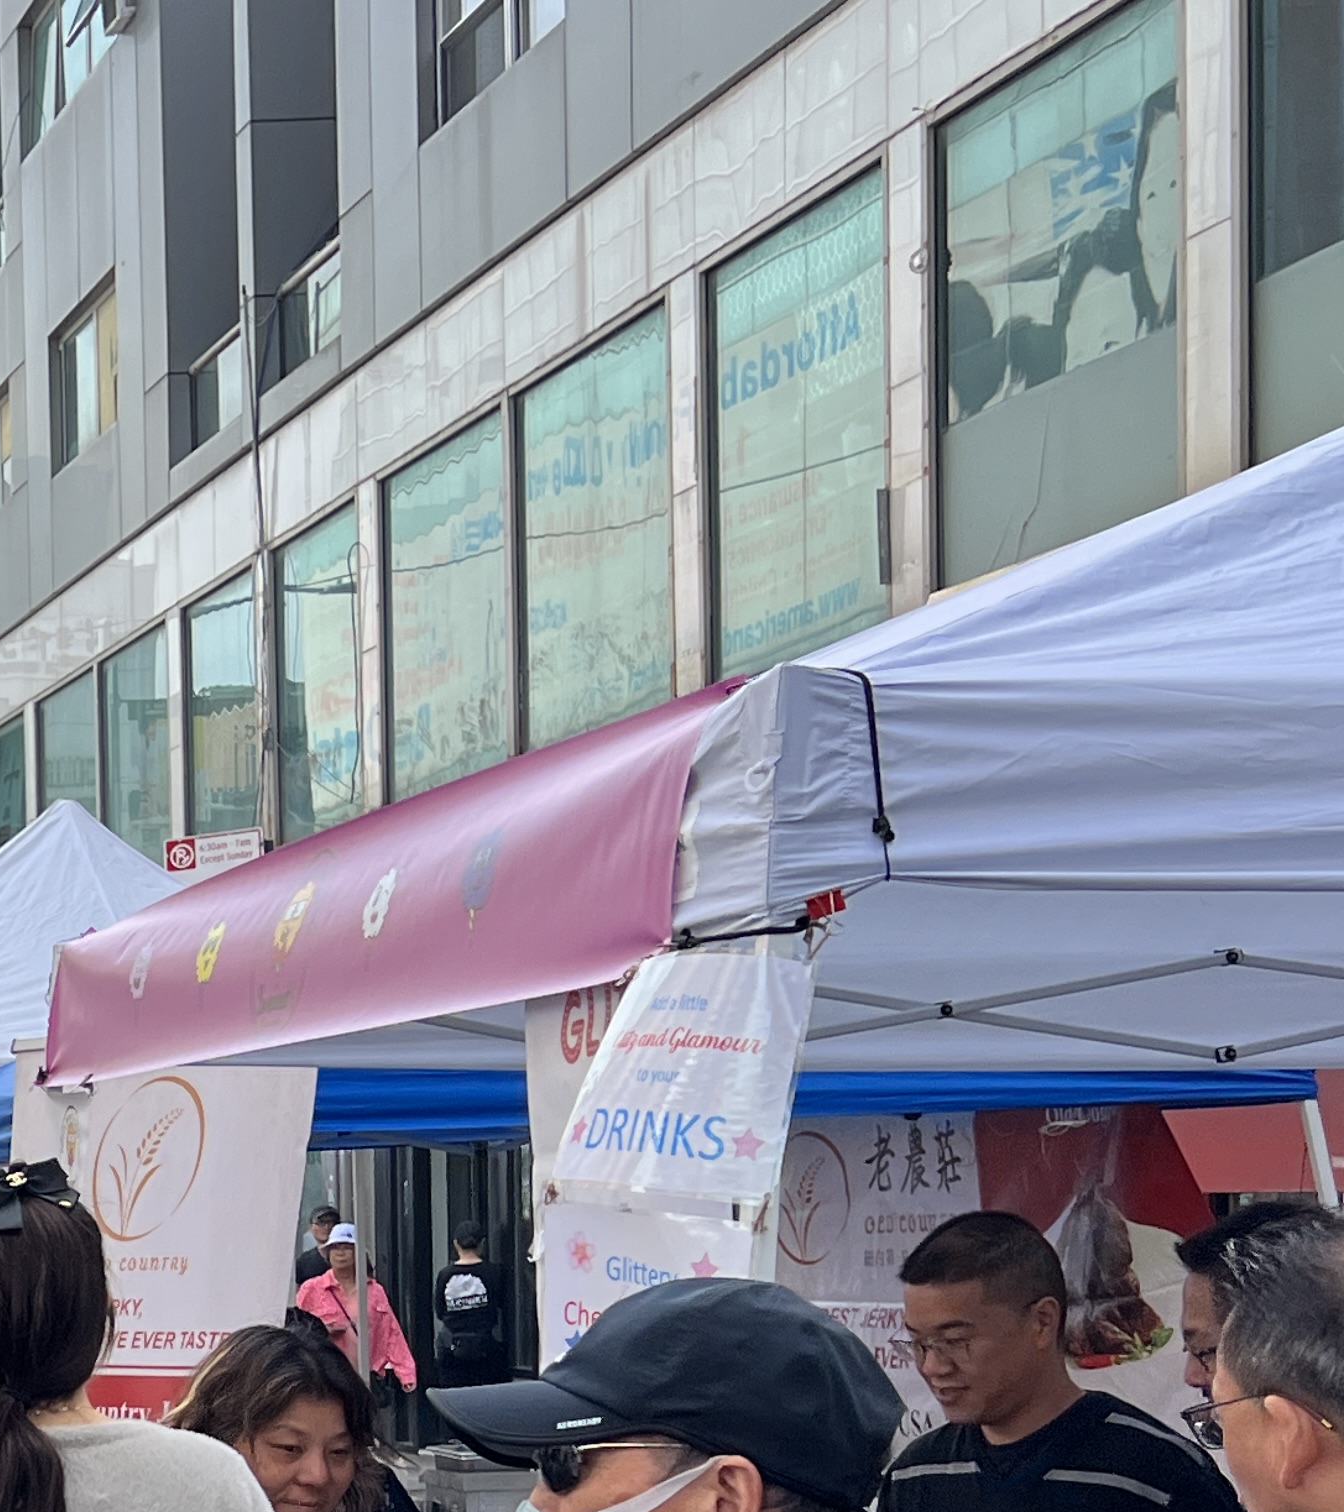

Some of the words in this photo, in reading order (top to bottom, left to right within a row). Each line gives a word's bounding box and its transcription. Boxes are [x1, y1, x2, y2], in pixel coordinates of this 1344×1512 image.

[227, 851, 253, 861] Sunday
[668, 1026, 762, 1055] Glamour
[637, 1068, 648, 1082] to
[585, 1108, 727, 1160] DRINKS
[564, 1301, 601, 1328] Che
[131, 1331, 176, 1350] EVER
